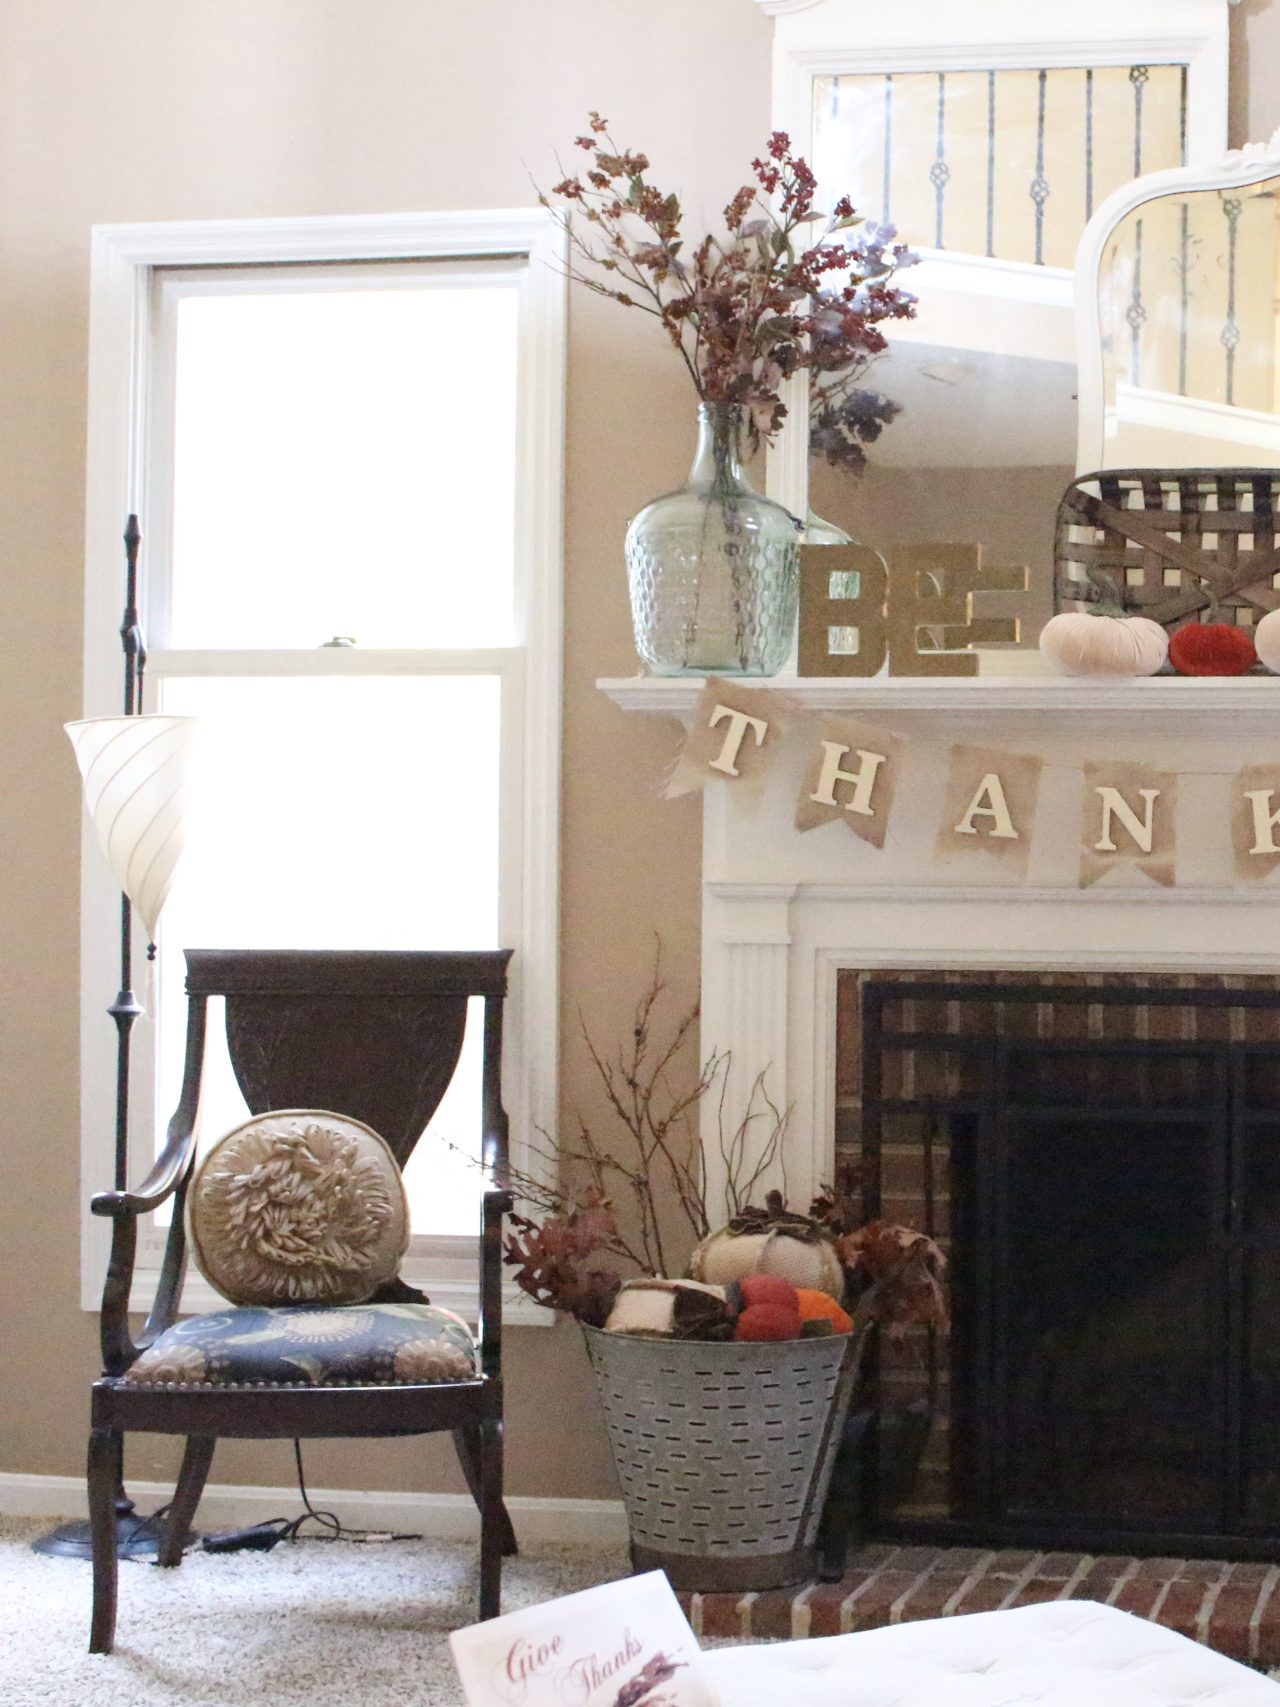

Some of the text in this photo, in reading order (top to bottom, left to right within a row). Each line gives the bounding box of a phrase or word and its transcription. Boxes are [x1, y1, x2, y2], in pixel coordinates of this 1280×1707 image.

[797, 543, 980, 678] BE
[500, 1633, 562, 1693] Give
[562, 1625, 643, 1699] Thanks
